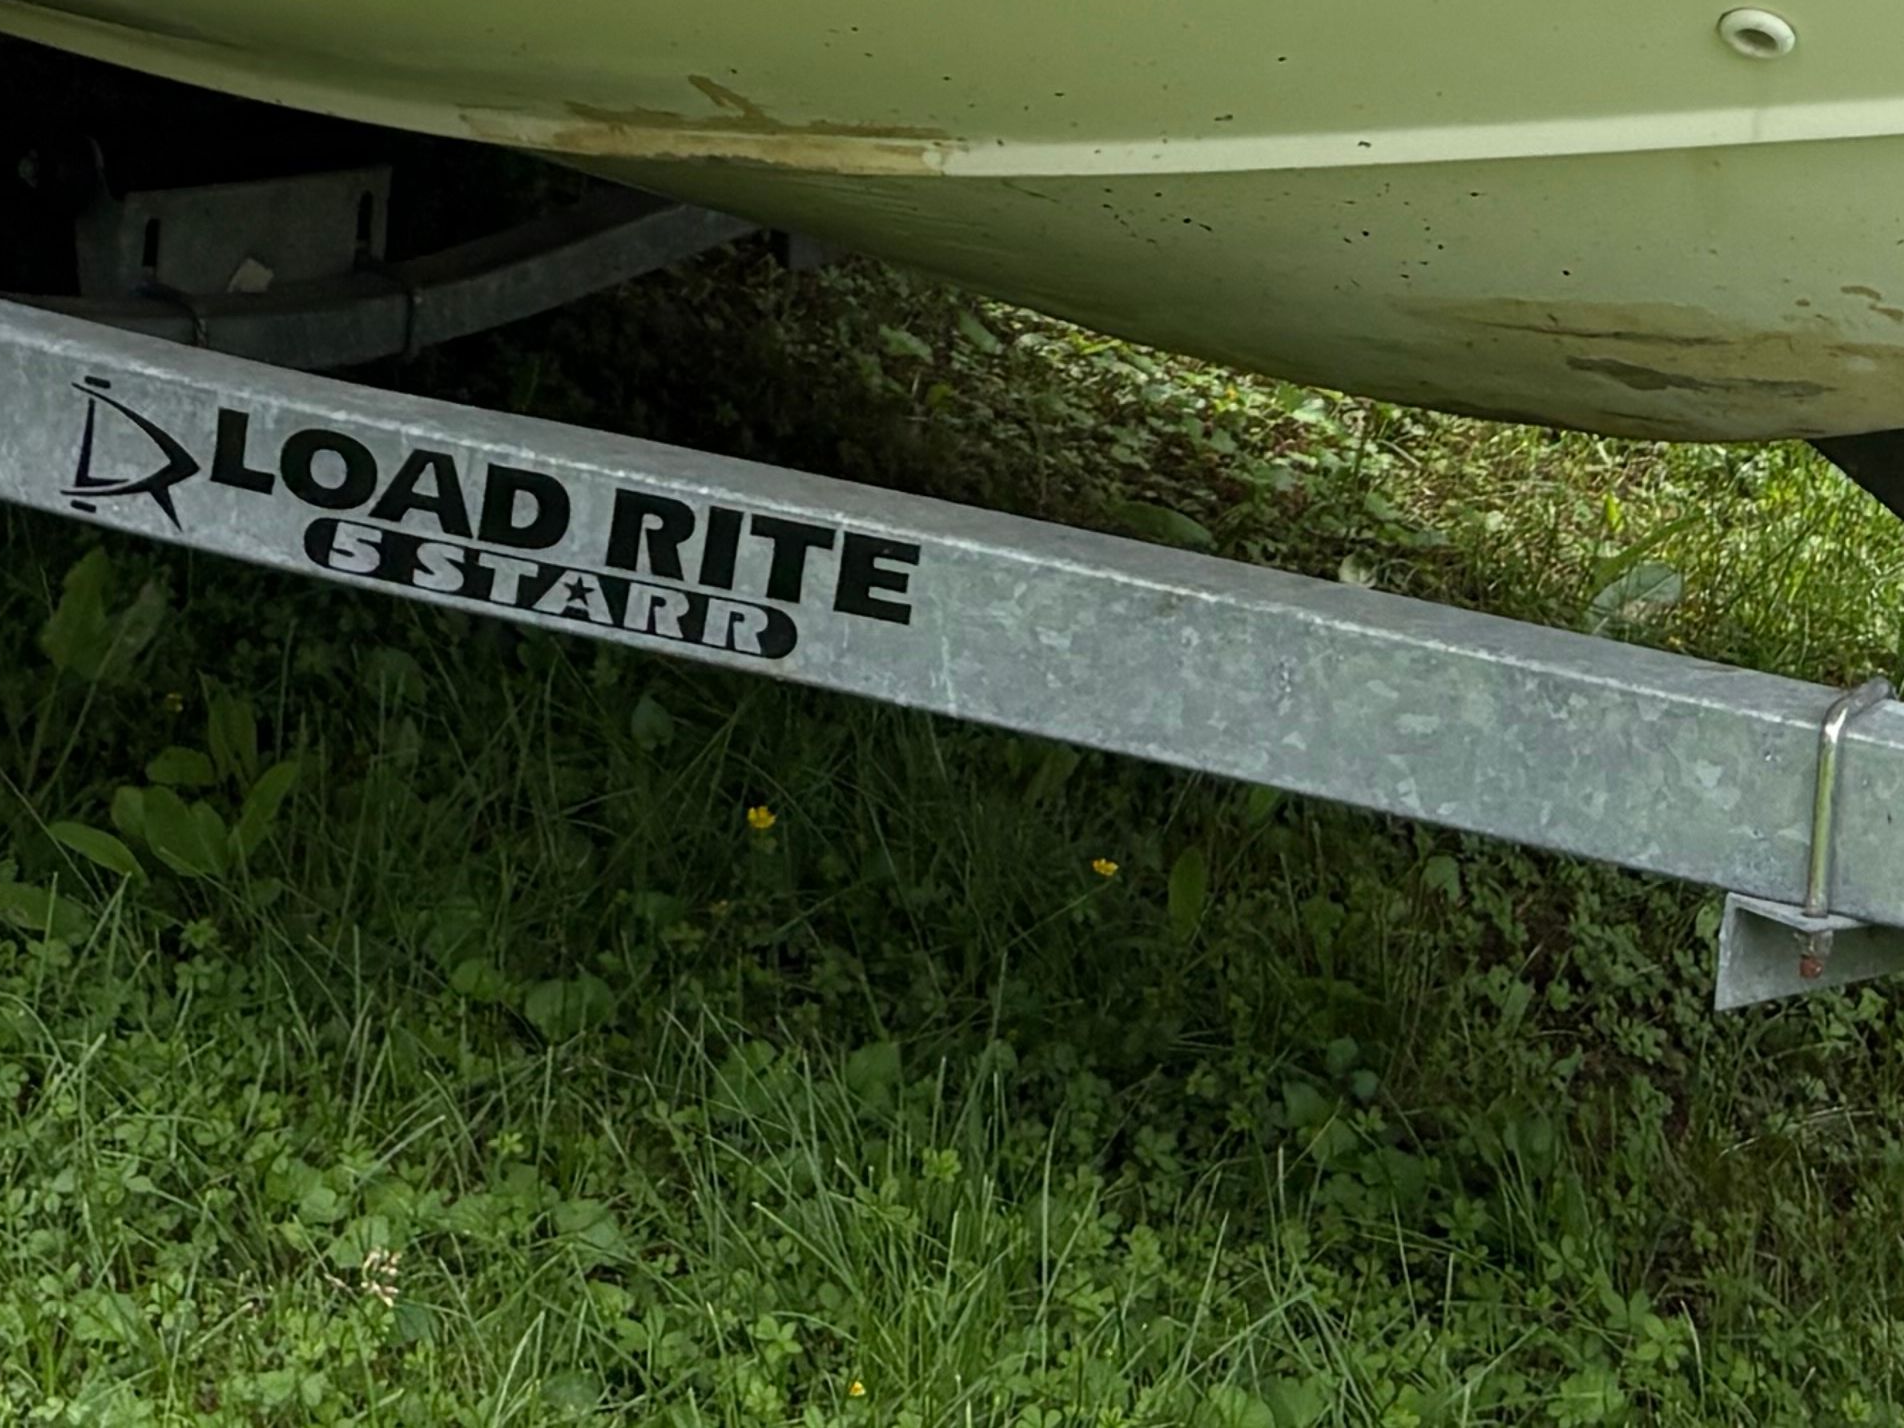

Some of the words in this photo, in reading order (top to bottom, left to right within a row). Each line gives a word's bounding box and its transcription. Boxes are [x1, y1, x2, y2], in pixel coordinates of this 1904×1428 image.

[208, 405, 572, 551] LOAD
[604, 487, 922, 626] RITE
[326, 525, 386, 576] 5
[411, 540, 772, 658] STARR
